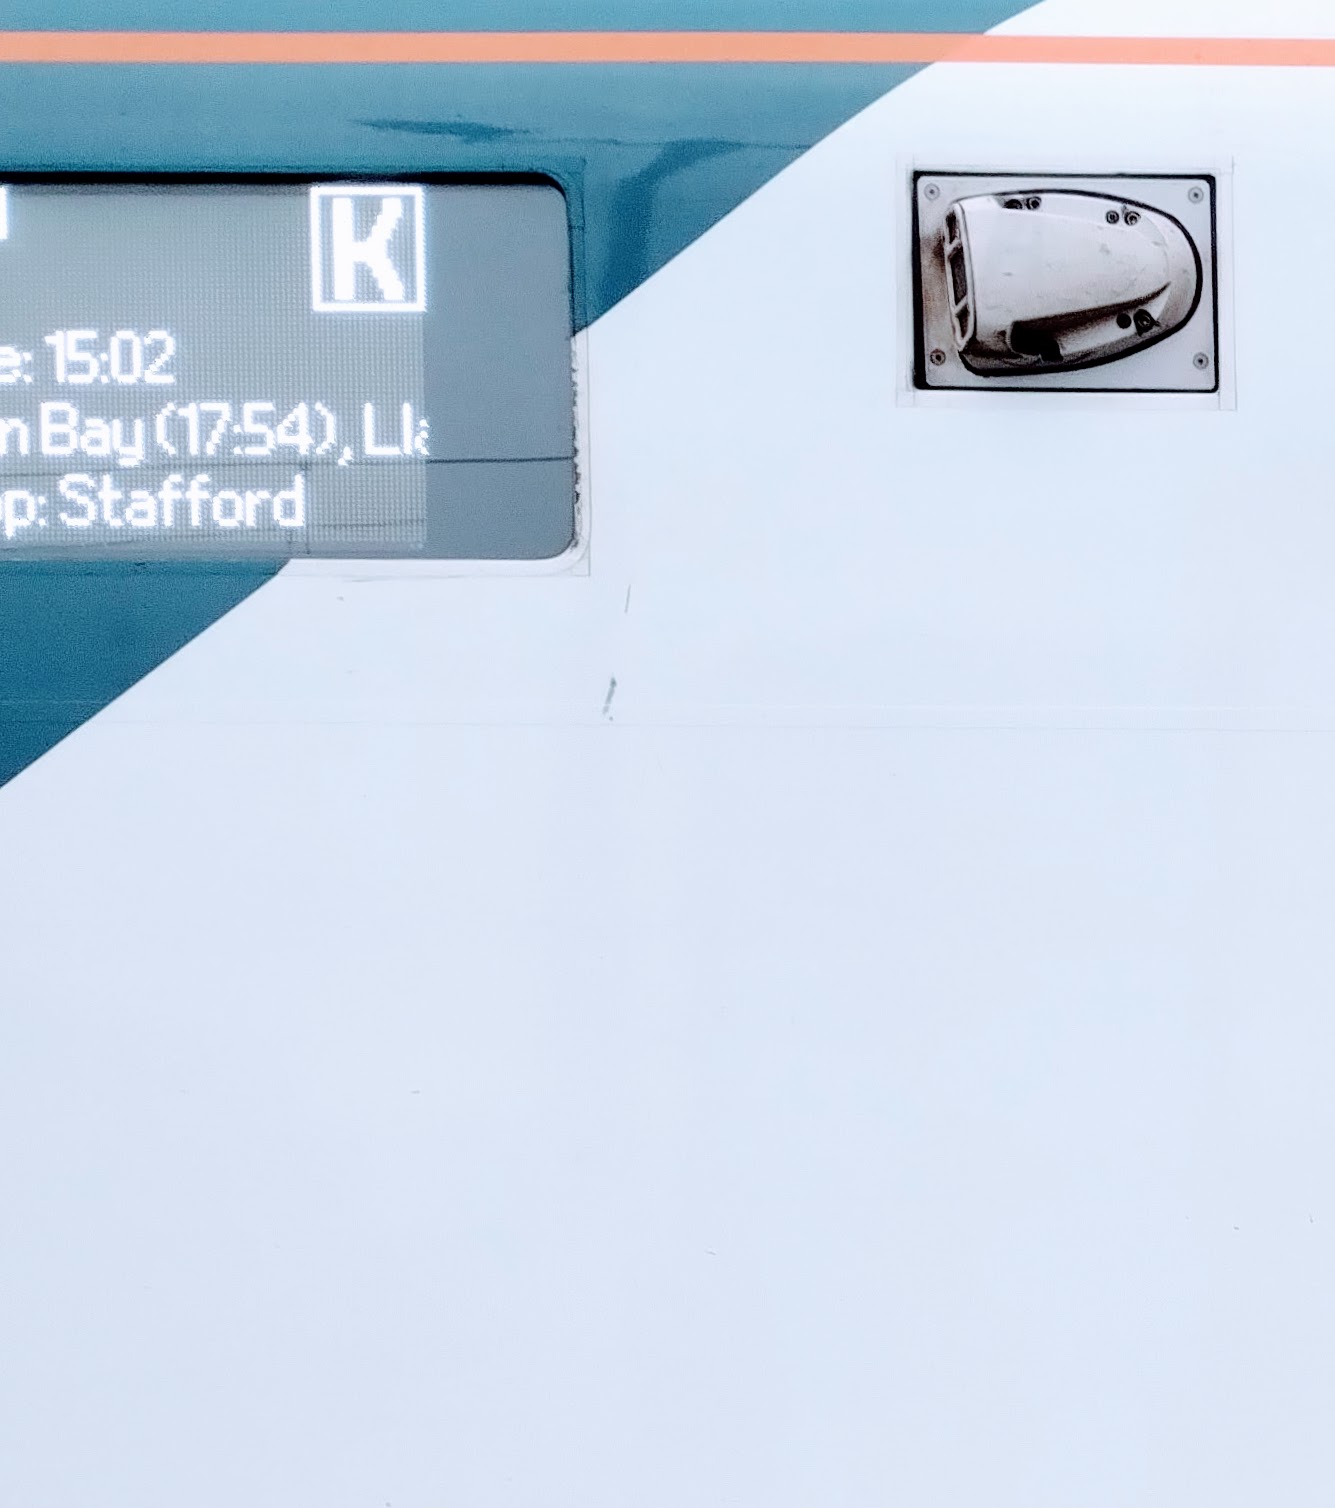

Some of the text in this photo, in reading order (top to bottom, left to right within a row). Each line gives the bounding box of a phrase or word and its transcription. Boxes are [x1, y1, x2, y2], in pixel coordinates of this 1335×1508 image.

[332, 198, 405, 301] K
[44, 330, 176, 384] 15:02
[41, 402, 145, 467] Bay
[156, 402, 353, 466] (17:54),
[58, 473, 305, 527] Stafford
